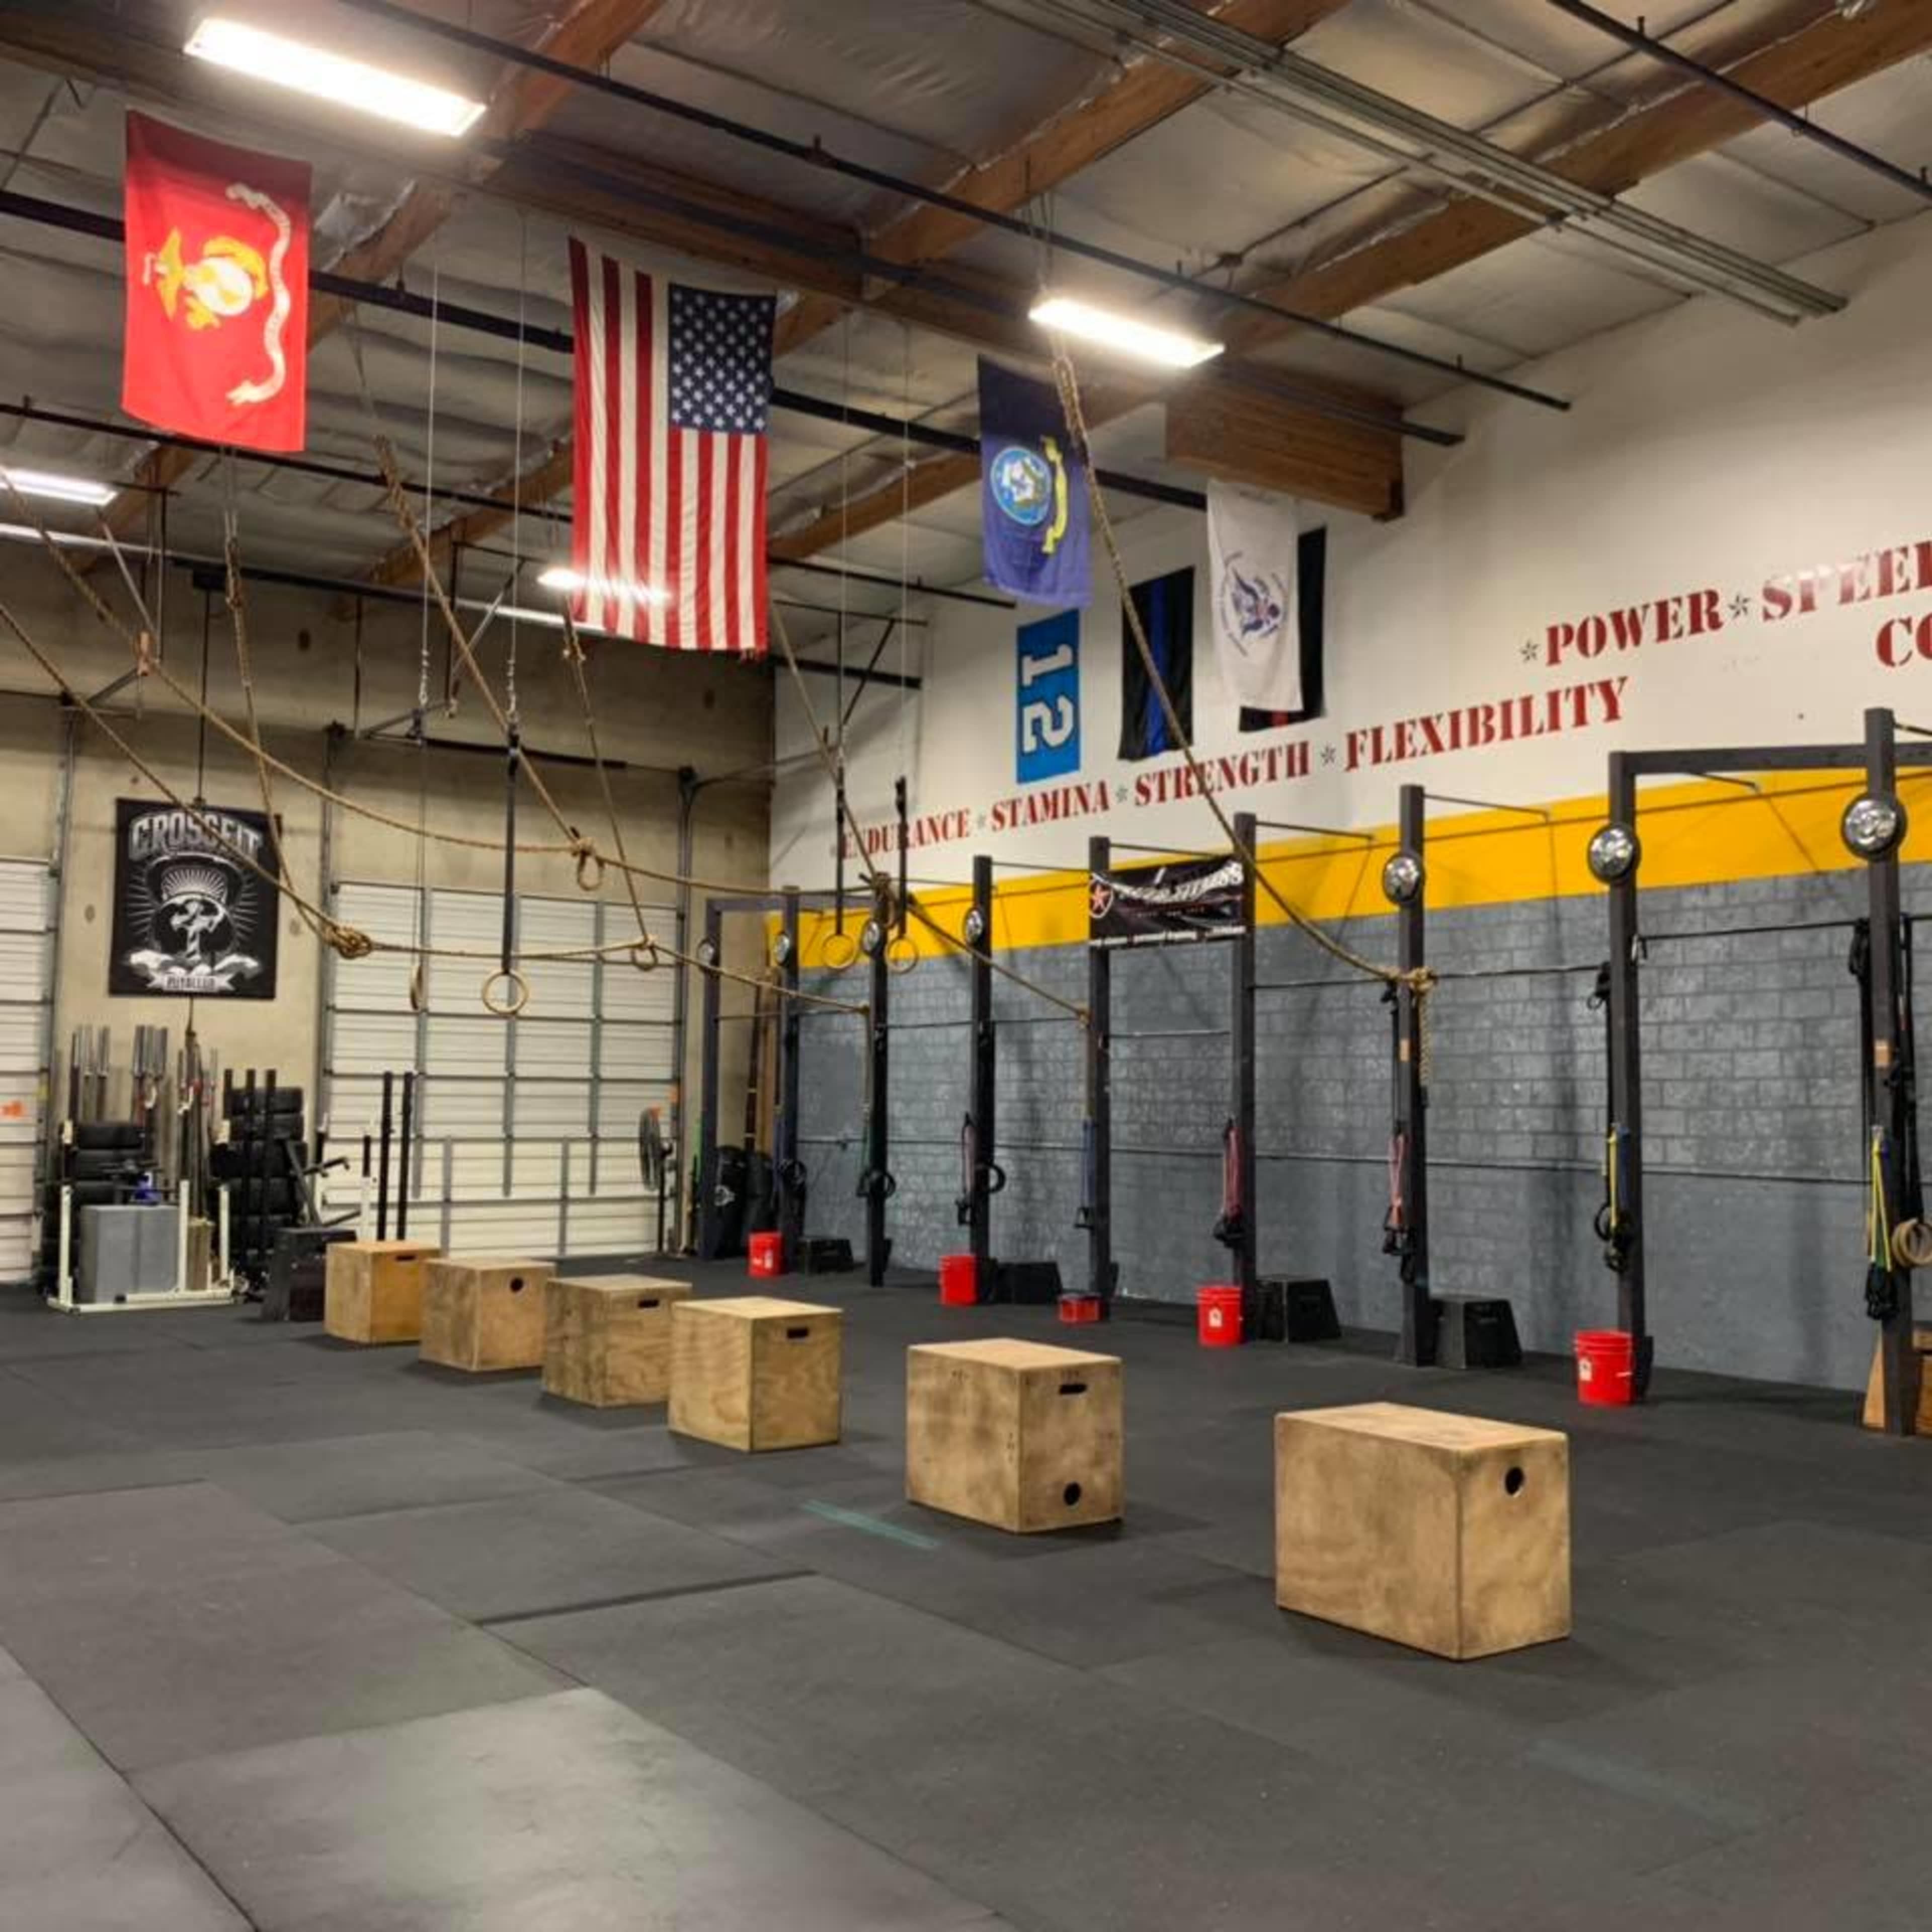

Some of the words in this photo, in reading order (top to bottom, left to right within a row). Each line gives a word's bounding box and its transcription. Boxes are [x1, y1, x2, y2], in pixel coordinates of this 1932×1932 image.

[1546, 589, 1724, 667] POWER
[1022, 643, 1073, 753] 12
[991, 780, 1110, 832] STAMINA
[1135, 740, 1310, 807] STRENGTH
[1344, 675, 1628, 772] FLEXIBILITY
[131, 811, 262, 856] CROSSFIT
